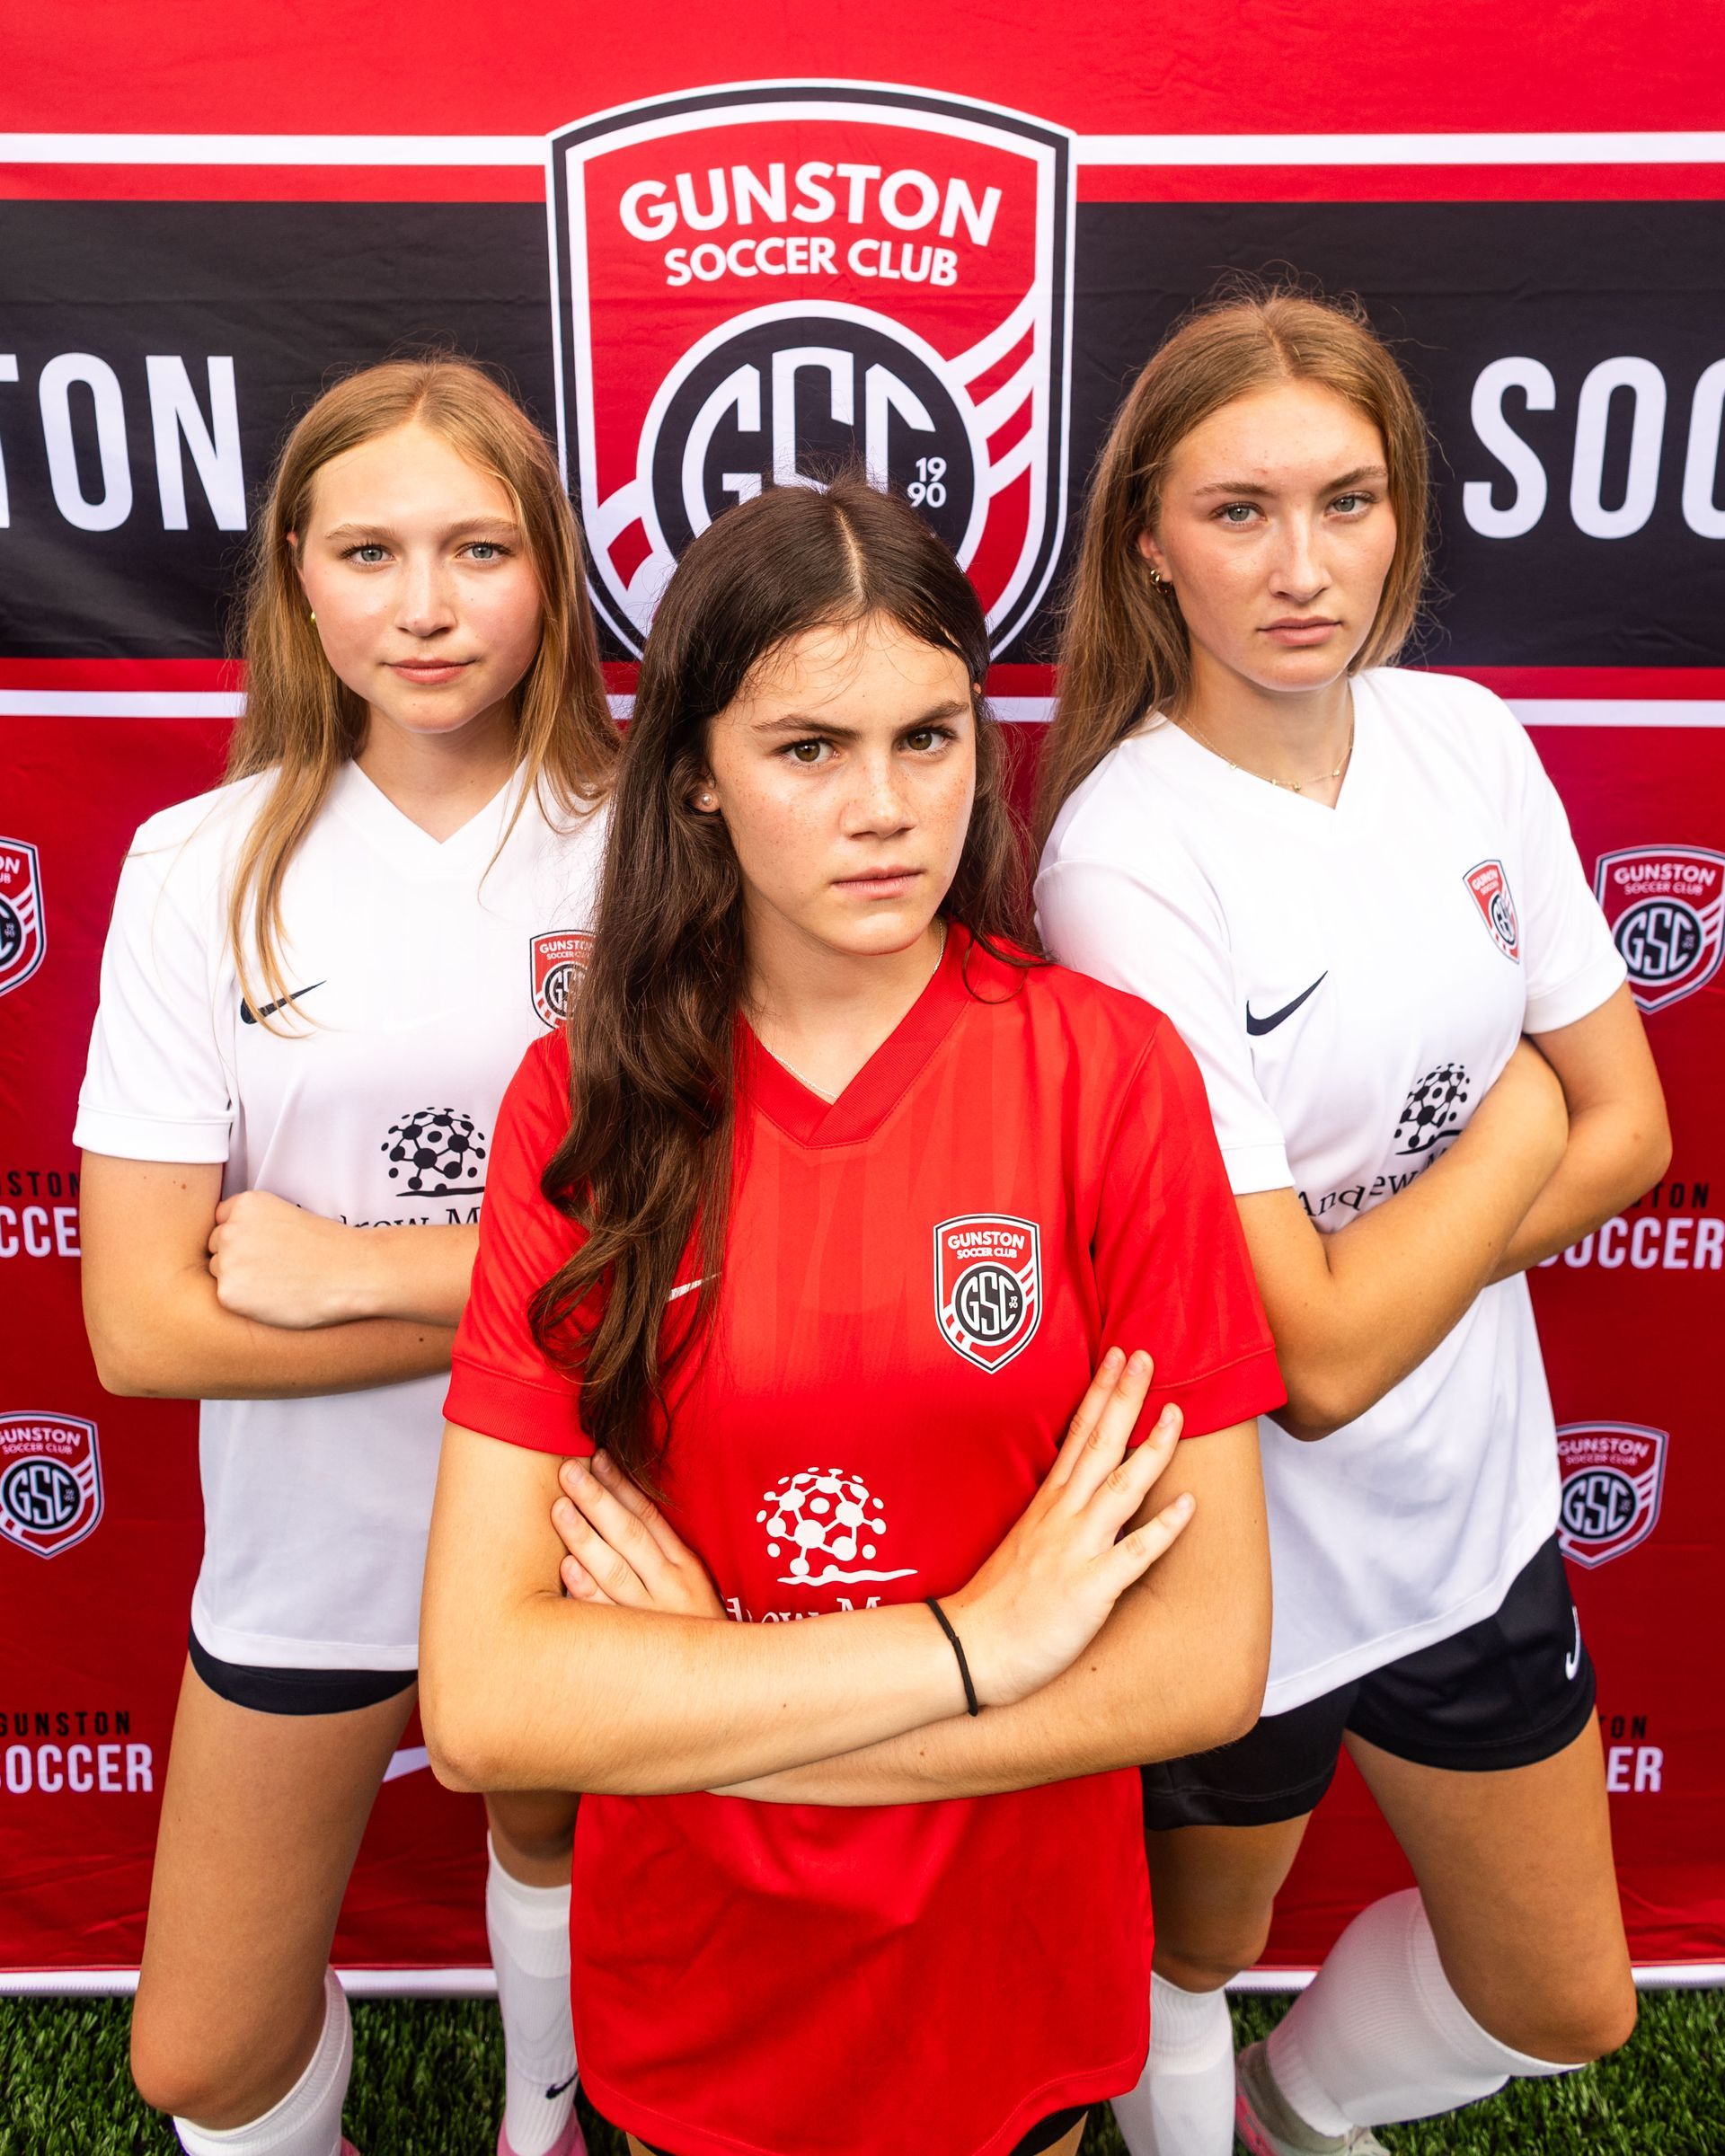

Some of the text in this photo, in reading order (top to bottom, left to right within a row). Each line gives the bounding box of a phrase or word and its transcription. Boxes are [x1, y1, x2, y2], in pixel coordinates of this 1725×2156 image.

[620, 162, 1002, 246] GUNSTON
[664, 236, 958, 287] SOCCER CLUB
[0, 352, 248, 532] ON
[916, 456, 948, 482] 19
[907, 482, 947, 508] 90
[1614, 862, 1716, 887] GUNSTON
[1623, 881, 1671, 895] SOCCER
[539, 940, 592, 954] GUNST
[1621, 906, 1693, 976] GSC
[0, 1171, 81, 1197] STON
[1298, 1171, 1419, 1216] Andew
[1631, 1182, 1710, 1209] TON
[948, 1231, 1025, 1250] GUNSTON
[957, 1247, 1018, 1259] SOCCER CLUB
[1536, 1216, 1725, 1270] OCCER
[960, 1271, 1016, 1335] GSC
[8, 1464, 73, 1525] GSC
[1563, 1475, 1628, 1535] GSC
[1599, 1715, 1648, 1739] ON
[0, 1743, 154, 1794] OCCER
[1606, 1746, 1664, 1793] ER
